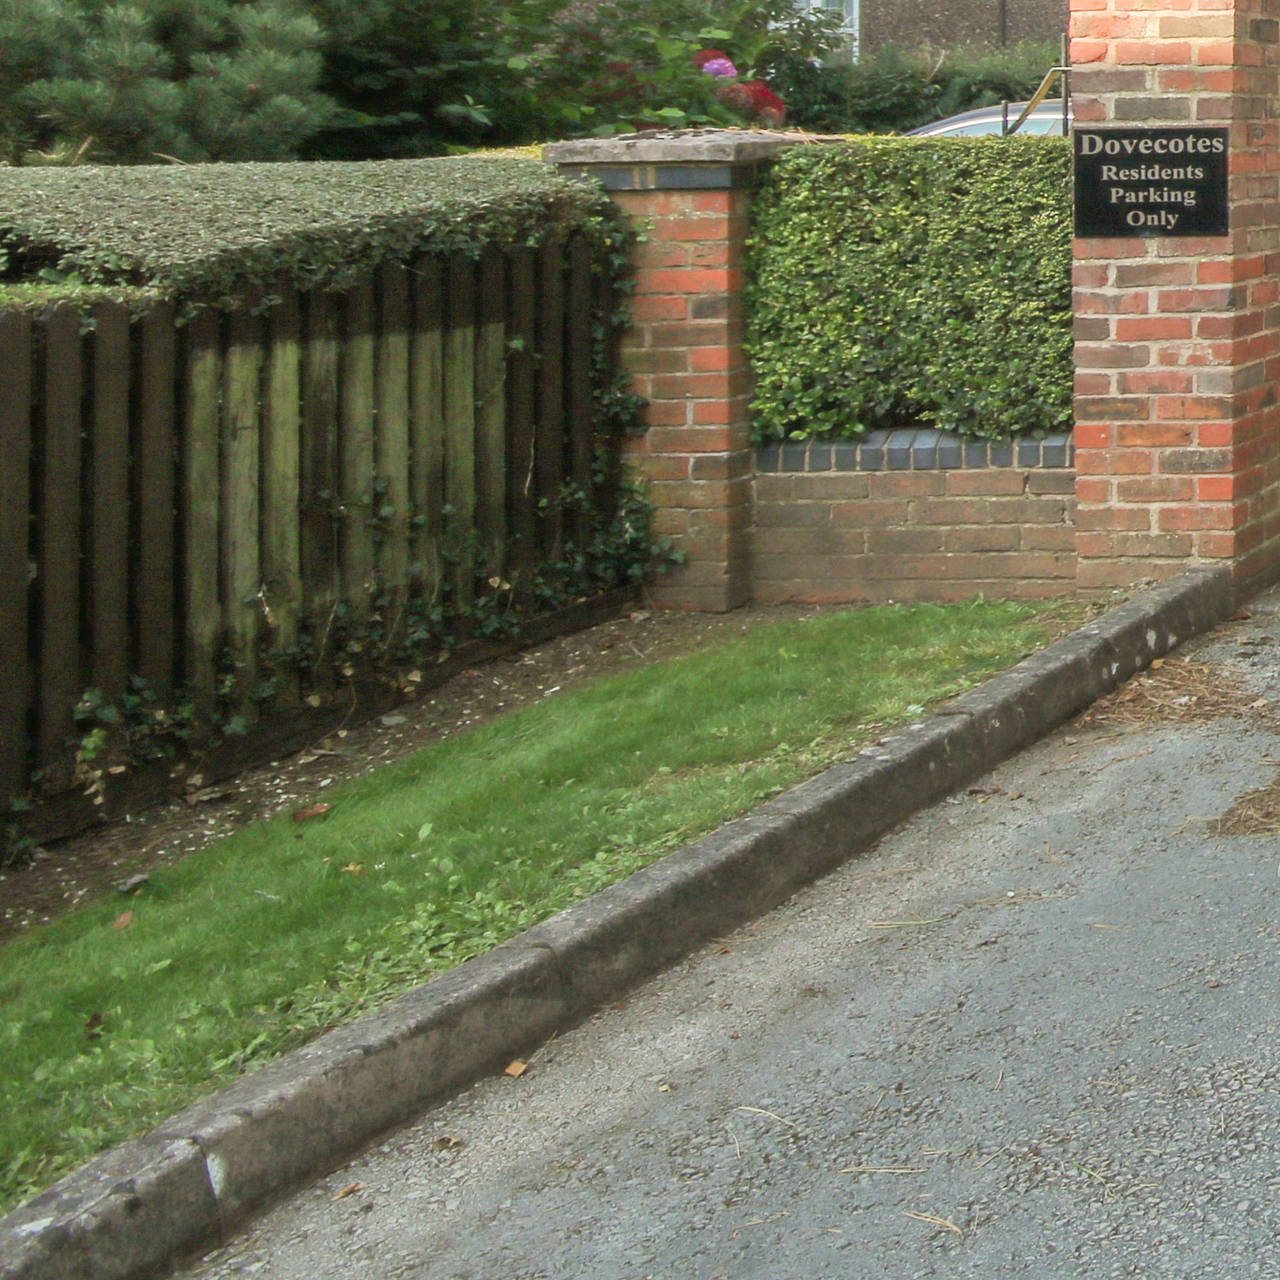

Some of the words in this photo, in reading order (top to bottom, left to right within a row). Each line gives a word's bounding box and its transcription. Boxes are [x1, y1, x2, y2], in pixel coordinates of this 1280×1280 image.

[1080, 134, 1224, 155] Dovecotes
[1101, 165, 1204, 181] Residents
[1110, 187, 1197, 206] Parking
[1126, 210, 1179, 229] Only
